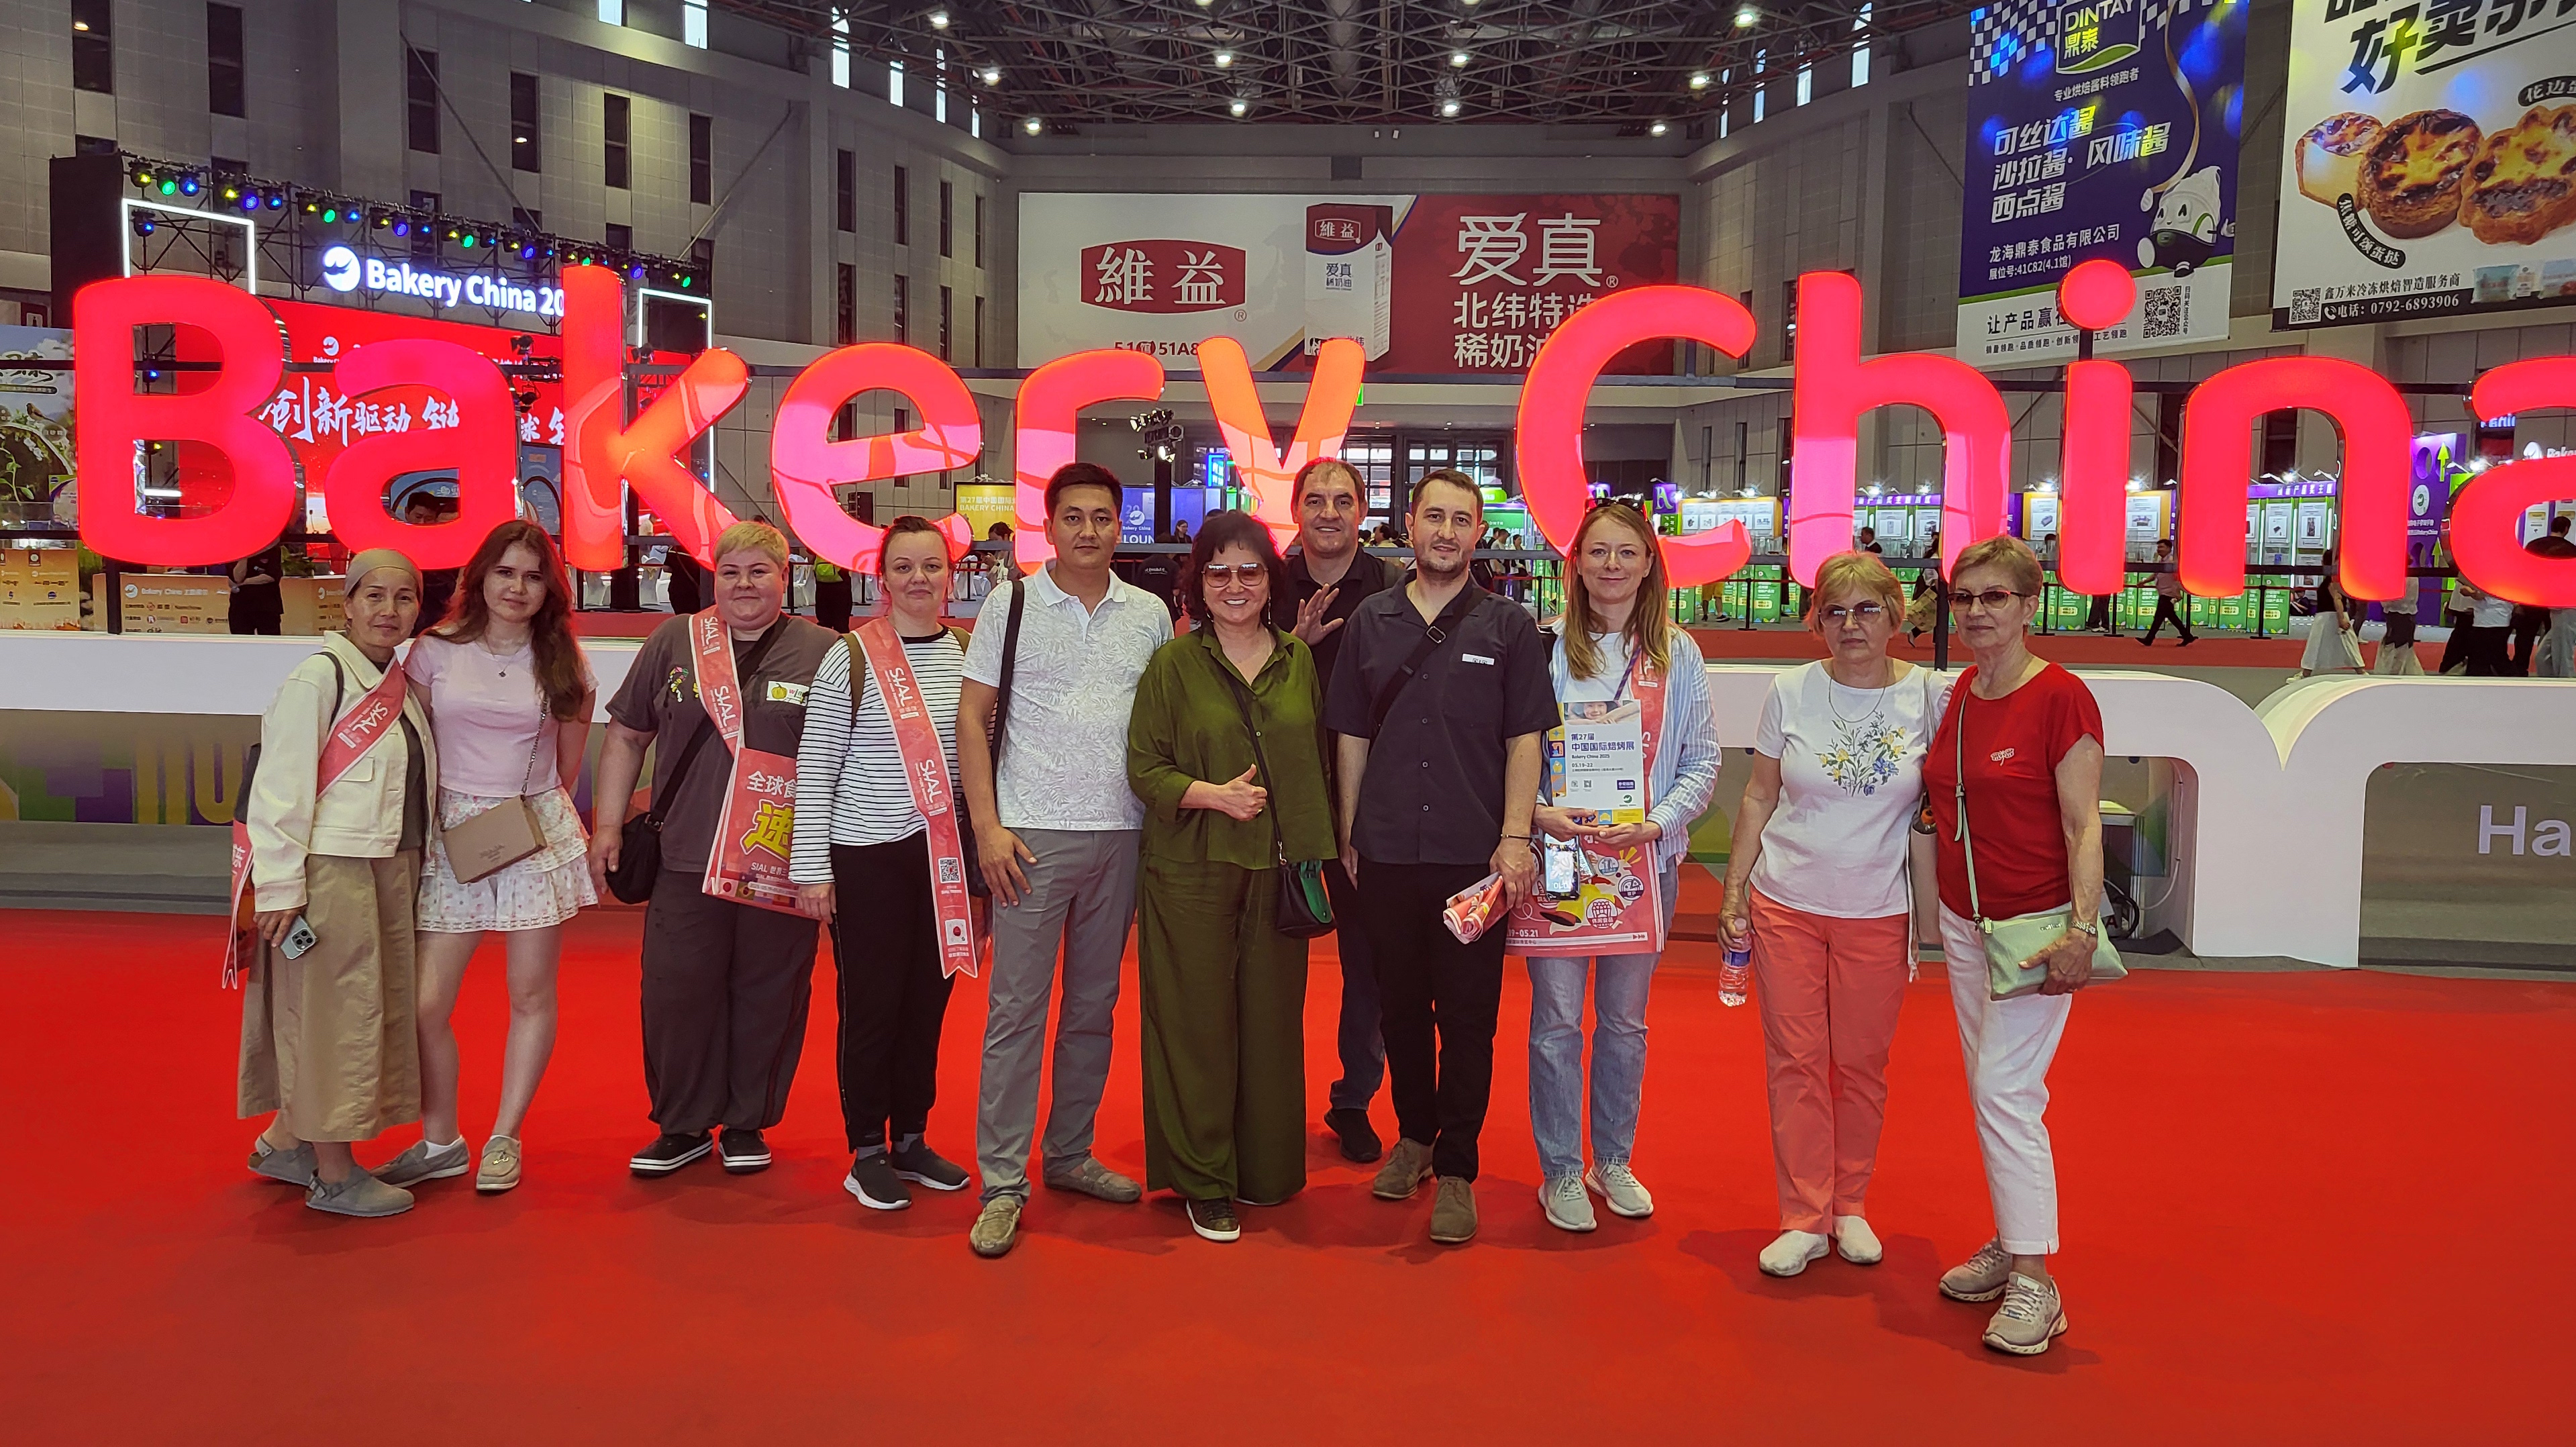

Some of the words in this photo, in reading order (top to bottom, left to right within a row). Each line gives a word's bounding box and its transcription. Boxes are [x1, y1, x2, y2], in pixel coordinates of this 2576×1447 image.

[2065, 0, 2134, 32] DINTAY
[2063, 27, 2099, 60] 鼎泰
[2054, 67, 2140, 102] 专业烘焙酱料领跑者
[1994, 105, 2097, 156] 可丝达酱
[2086, 122, 2172, 170] 风味酱
[1991, 181, 2067, 223] 西点酱
[1448, 213, 1603, 287] 爱真
[1989, 223, 2120, 264] 龙海鼎泰食品有限公司
[366, 258, 462, 307] Bakery
[465, 275, 537, 313] China
[1094, 246, 1227, 305] 維益
[1326, 262, 1352, 278] 爱真
[1988, 254, 2072, 281] 展位号:41C82(4.1馆)
[2324, 272, 2461, 301] 鑫万来冷冻烘焙智造服务商
[2370, 293, 2460, 315] 0792-6893906
[2093, 329, 2128, 341] 工艺领跑
[258, 377, 411, 446] 创新驱动
[74, 265, 1365, 572] Bakery
[1518, 259, 2576, 607] China
[705, 616, 720, 646] SIAL
[714, 685, 736, 728] SIAL
[889, 667, 913, 707] SIAL
[352, 701, 389, 734] SIAL
[920, 759, 943, 803] SIAL
[2478, 805, 2571, 857] Ha
[750, 862, 769, 873] SIAL
